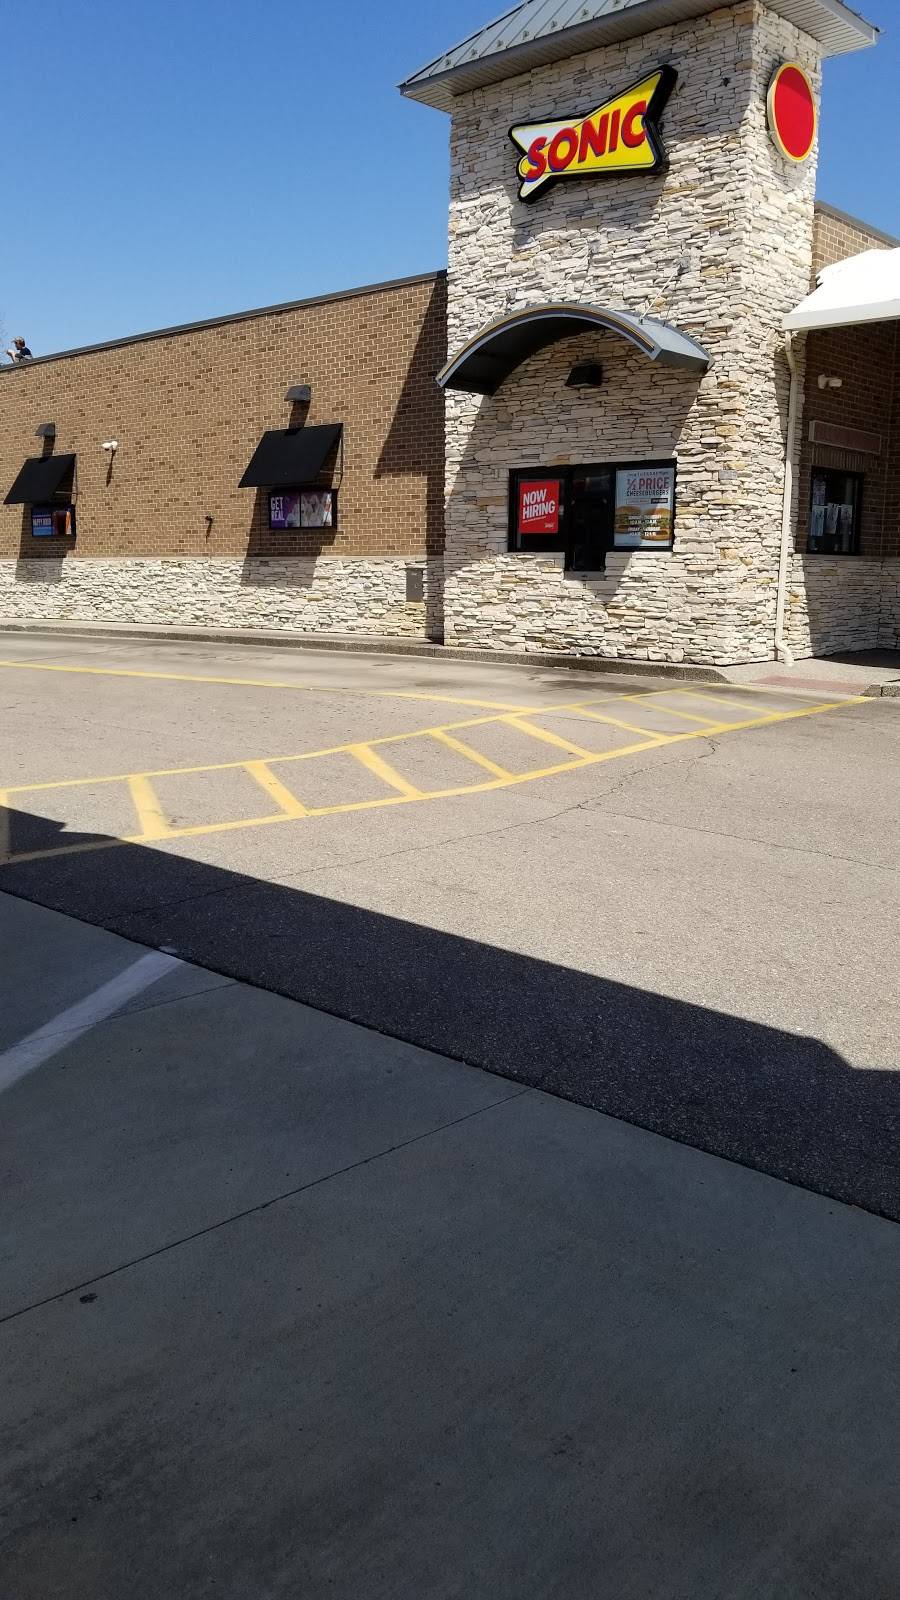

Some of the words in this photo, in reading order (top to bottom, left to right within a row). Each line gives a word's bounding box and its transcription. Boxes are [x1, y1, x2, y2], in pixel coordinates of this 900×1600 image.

[525, 100, 647, 182] SONIC
[638, 477, 670, 491] PRICE
[271, 497, 284, 510] GET
[523, 489, 547, 506] NOW
[271, 510, 285, 521] REAL
[522, 500, 555, 519] HIRING
